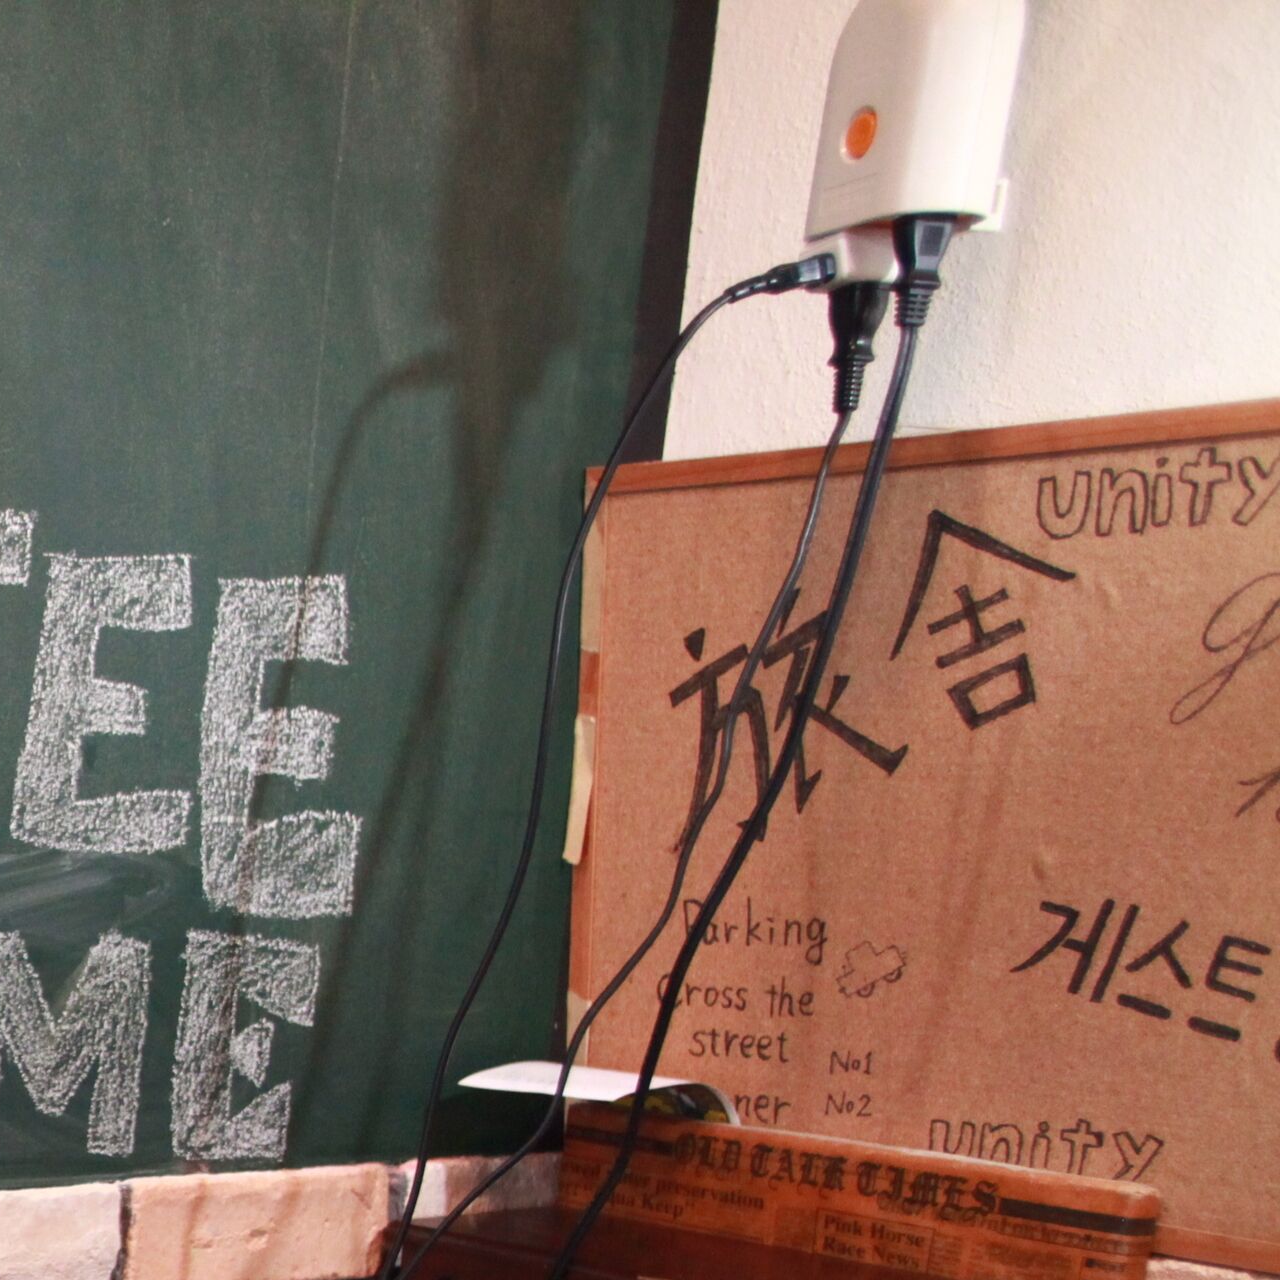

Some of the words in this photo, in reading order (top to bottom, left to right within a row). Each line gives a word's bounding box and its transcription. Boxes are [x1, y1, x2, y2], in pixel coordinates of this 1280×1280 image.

[683, 896, 828, 966] Parking
[765, 975, 816, 1018] the
[688, 1028, 790, 1064] street
[829, 1050, 873, 1076] No1
[824, 1092, 873, 1118] No2
[857, 1160, 1000, 1216] TIMES
[823, 1214, 863, 1237] Pink
[869, 1222, 927, 1248] Horse
[872, 1243, 922, 1270] News
